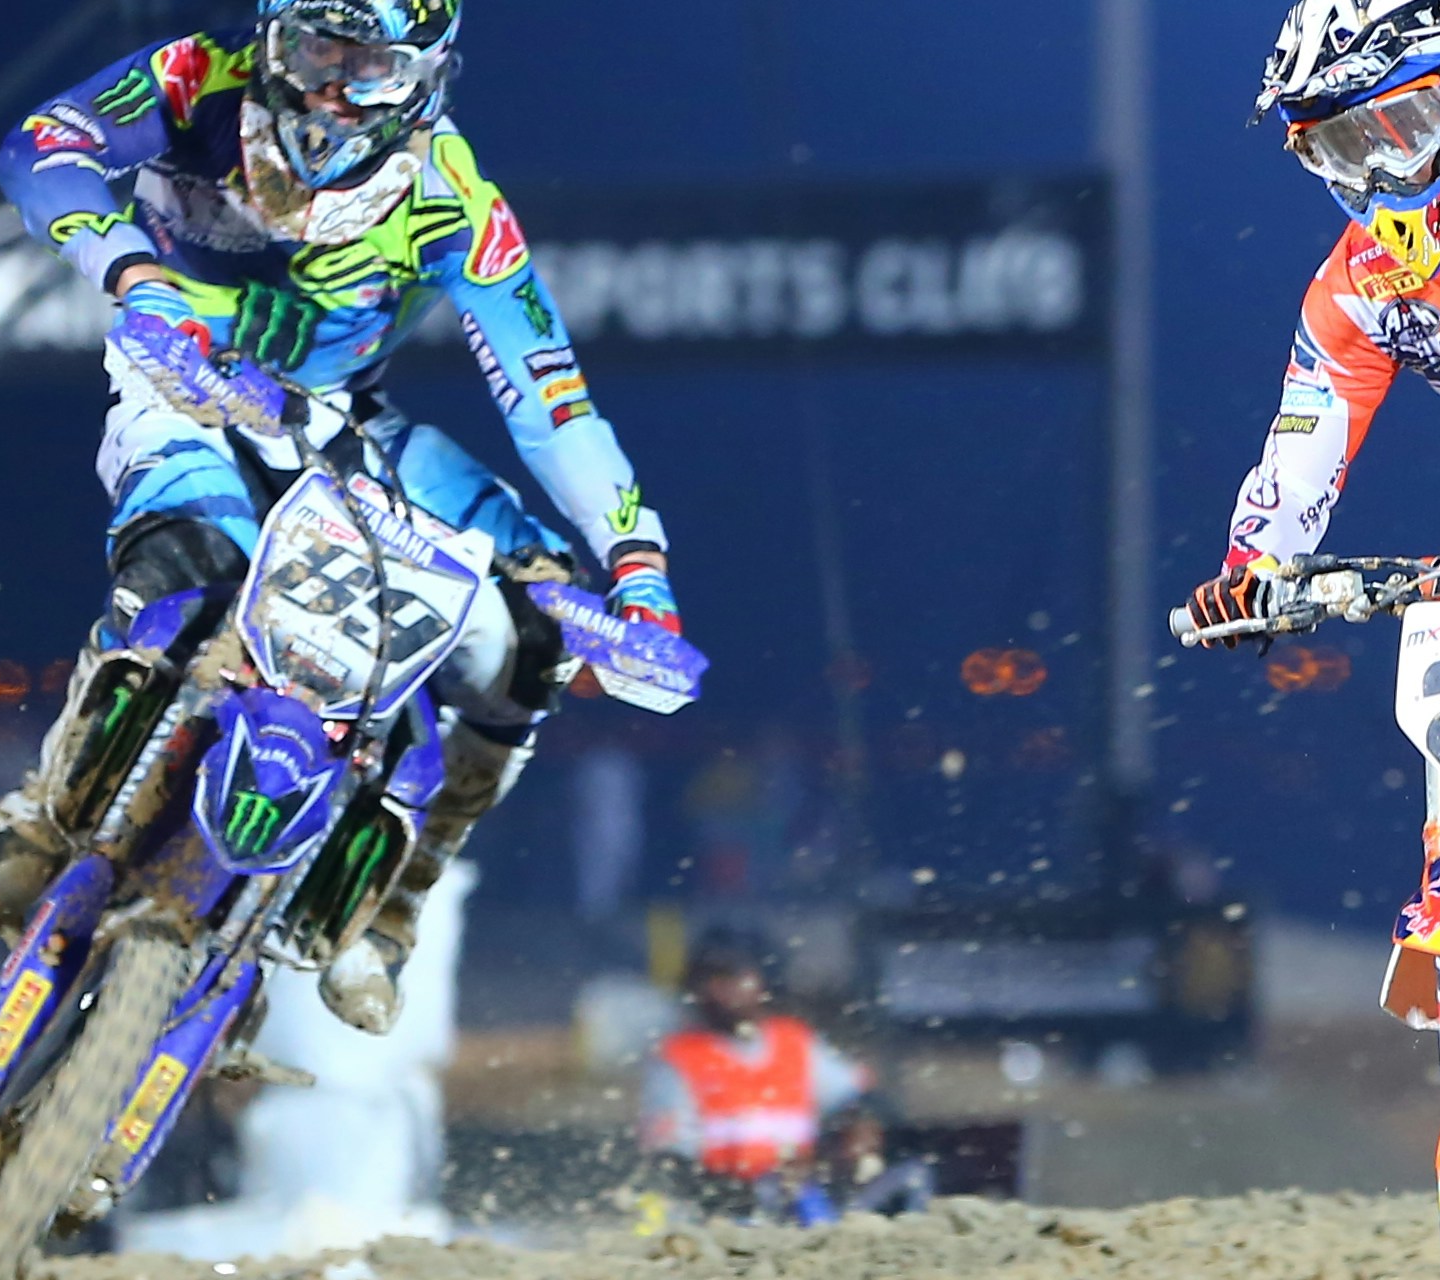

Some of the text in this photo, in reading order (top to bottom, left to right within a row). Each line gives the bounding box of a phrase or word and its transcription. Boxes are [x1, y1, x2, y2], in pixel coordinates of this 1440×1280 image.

[545, 237, 847, 337] PORTS
[462, 311, 519, 415] YAMAHA
[360, 502, 438, 568] YAMAHA
[555, 598, 627, 647] YAMAHA
